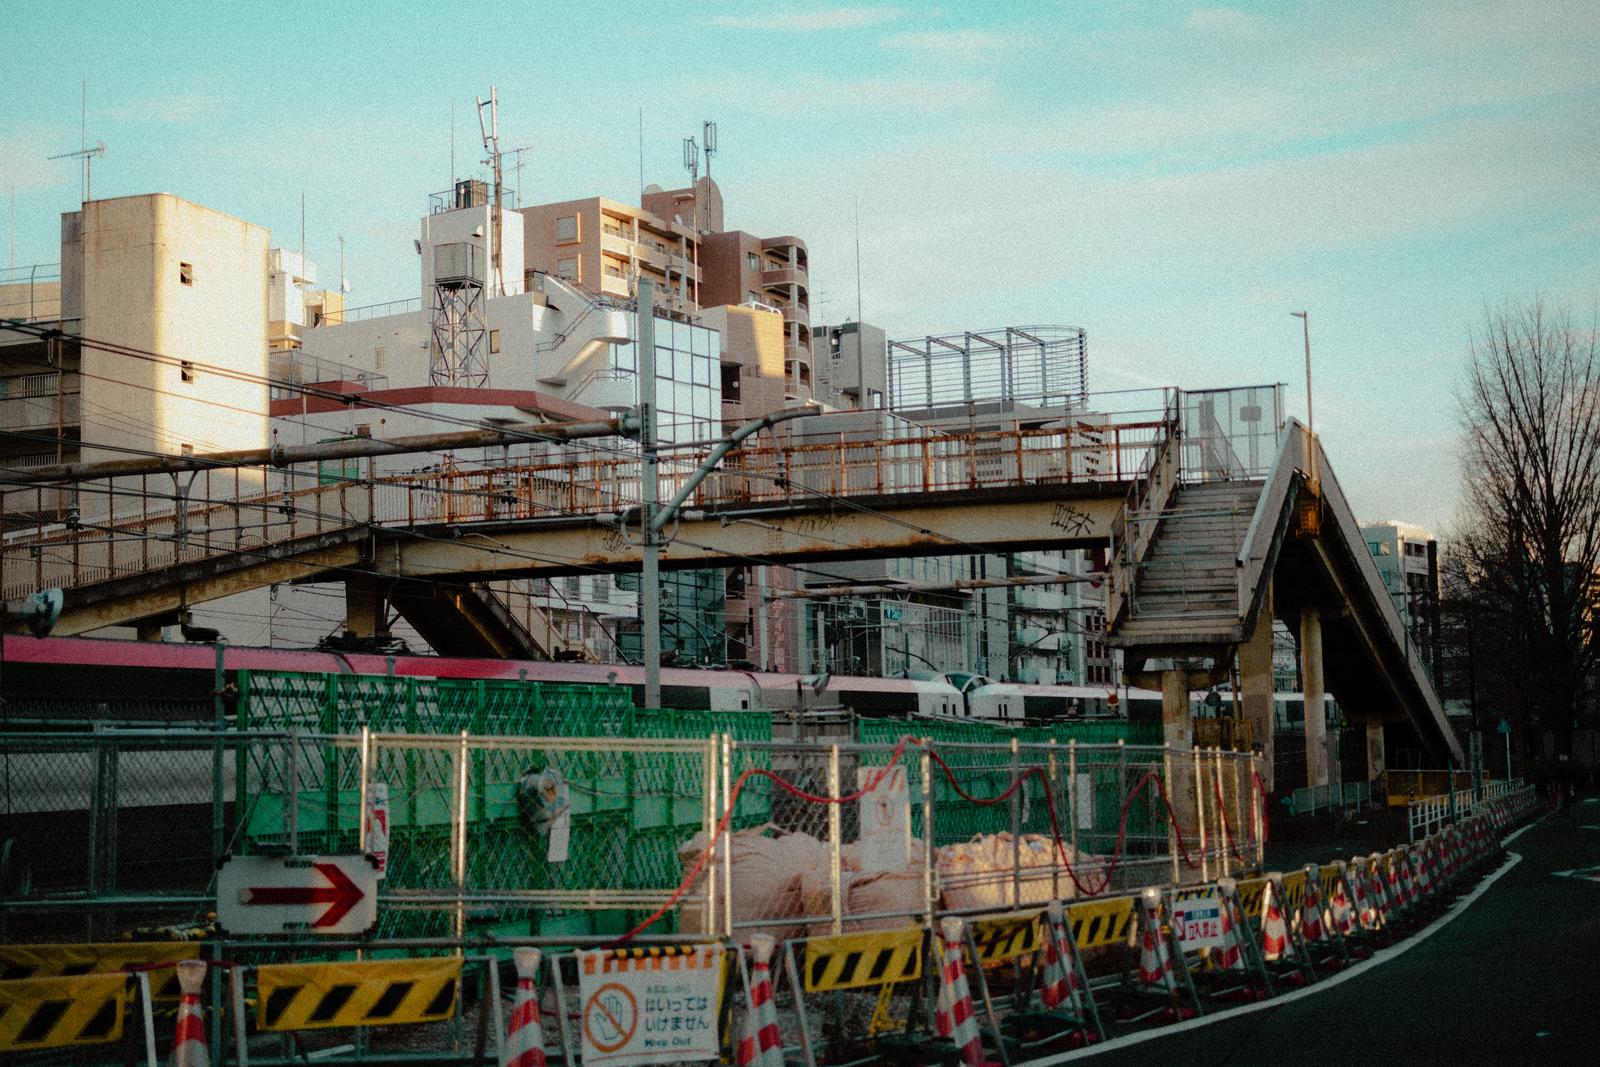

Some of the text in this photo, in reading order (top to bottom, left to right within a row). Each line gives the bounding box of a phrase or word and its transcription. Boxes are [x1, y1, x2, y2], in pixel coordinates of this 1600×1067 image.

[1188, 921, 1218, 941] 立入禁止
[645, 997, 708, 1012] はいっては
[645, 1016, 709, 1032] いけません
[644, 1037, 691, 1048] Keep Out
